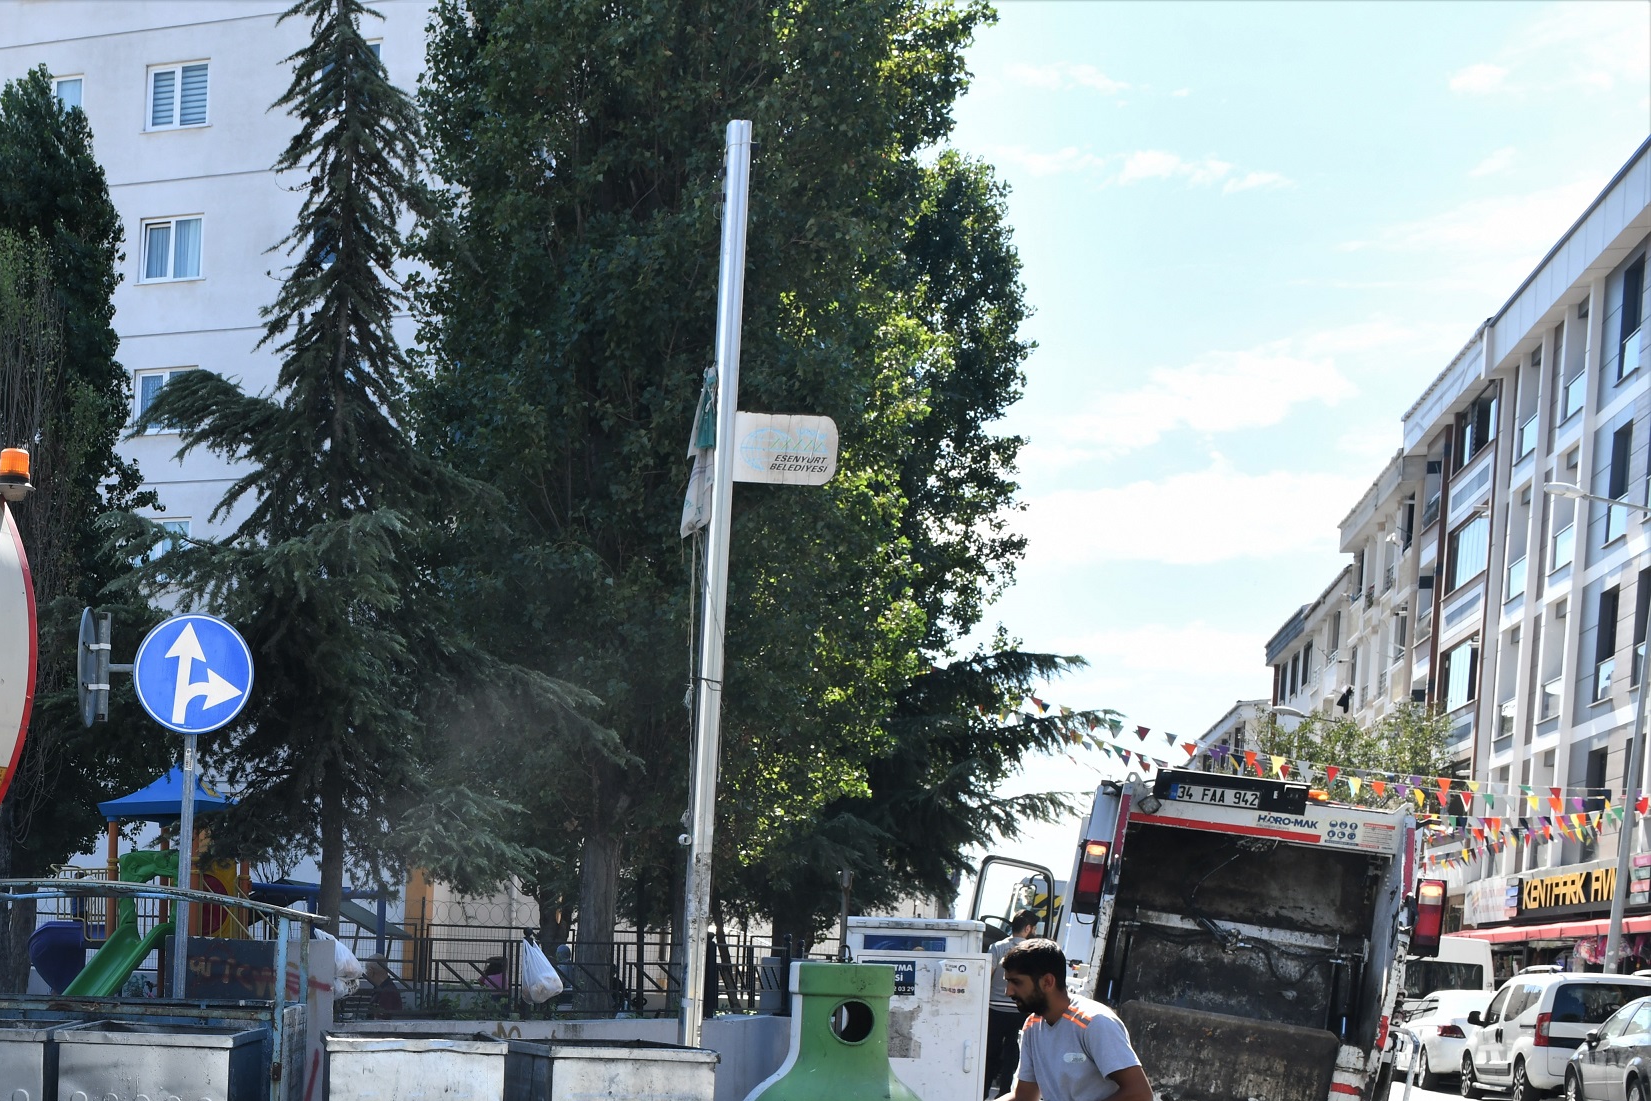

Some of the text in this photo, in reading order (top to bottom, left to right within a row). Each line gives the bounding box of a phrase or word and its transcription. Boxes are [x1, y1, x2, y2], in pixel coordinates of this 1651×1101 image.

[769, 462, 828, 473] BELEDİYESİ
[774, 454, 827, 465] ESENYURT
[1177, 785, 1259, 807] 34 FAA 942
[1522, 871, 1588, 910] KENTPARK
